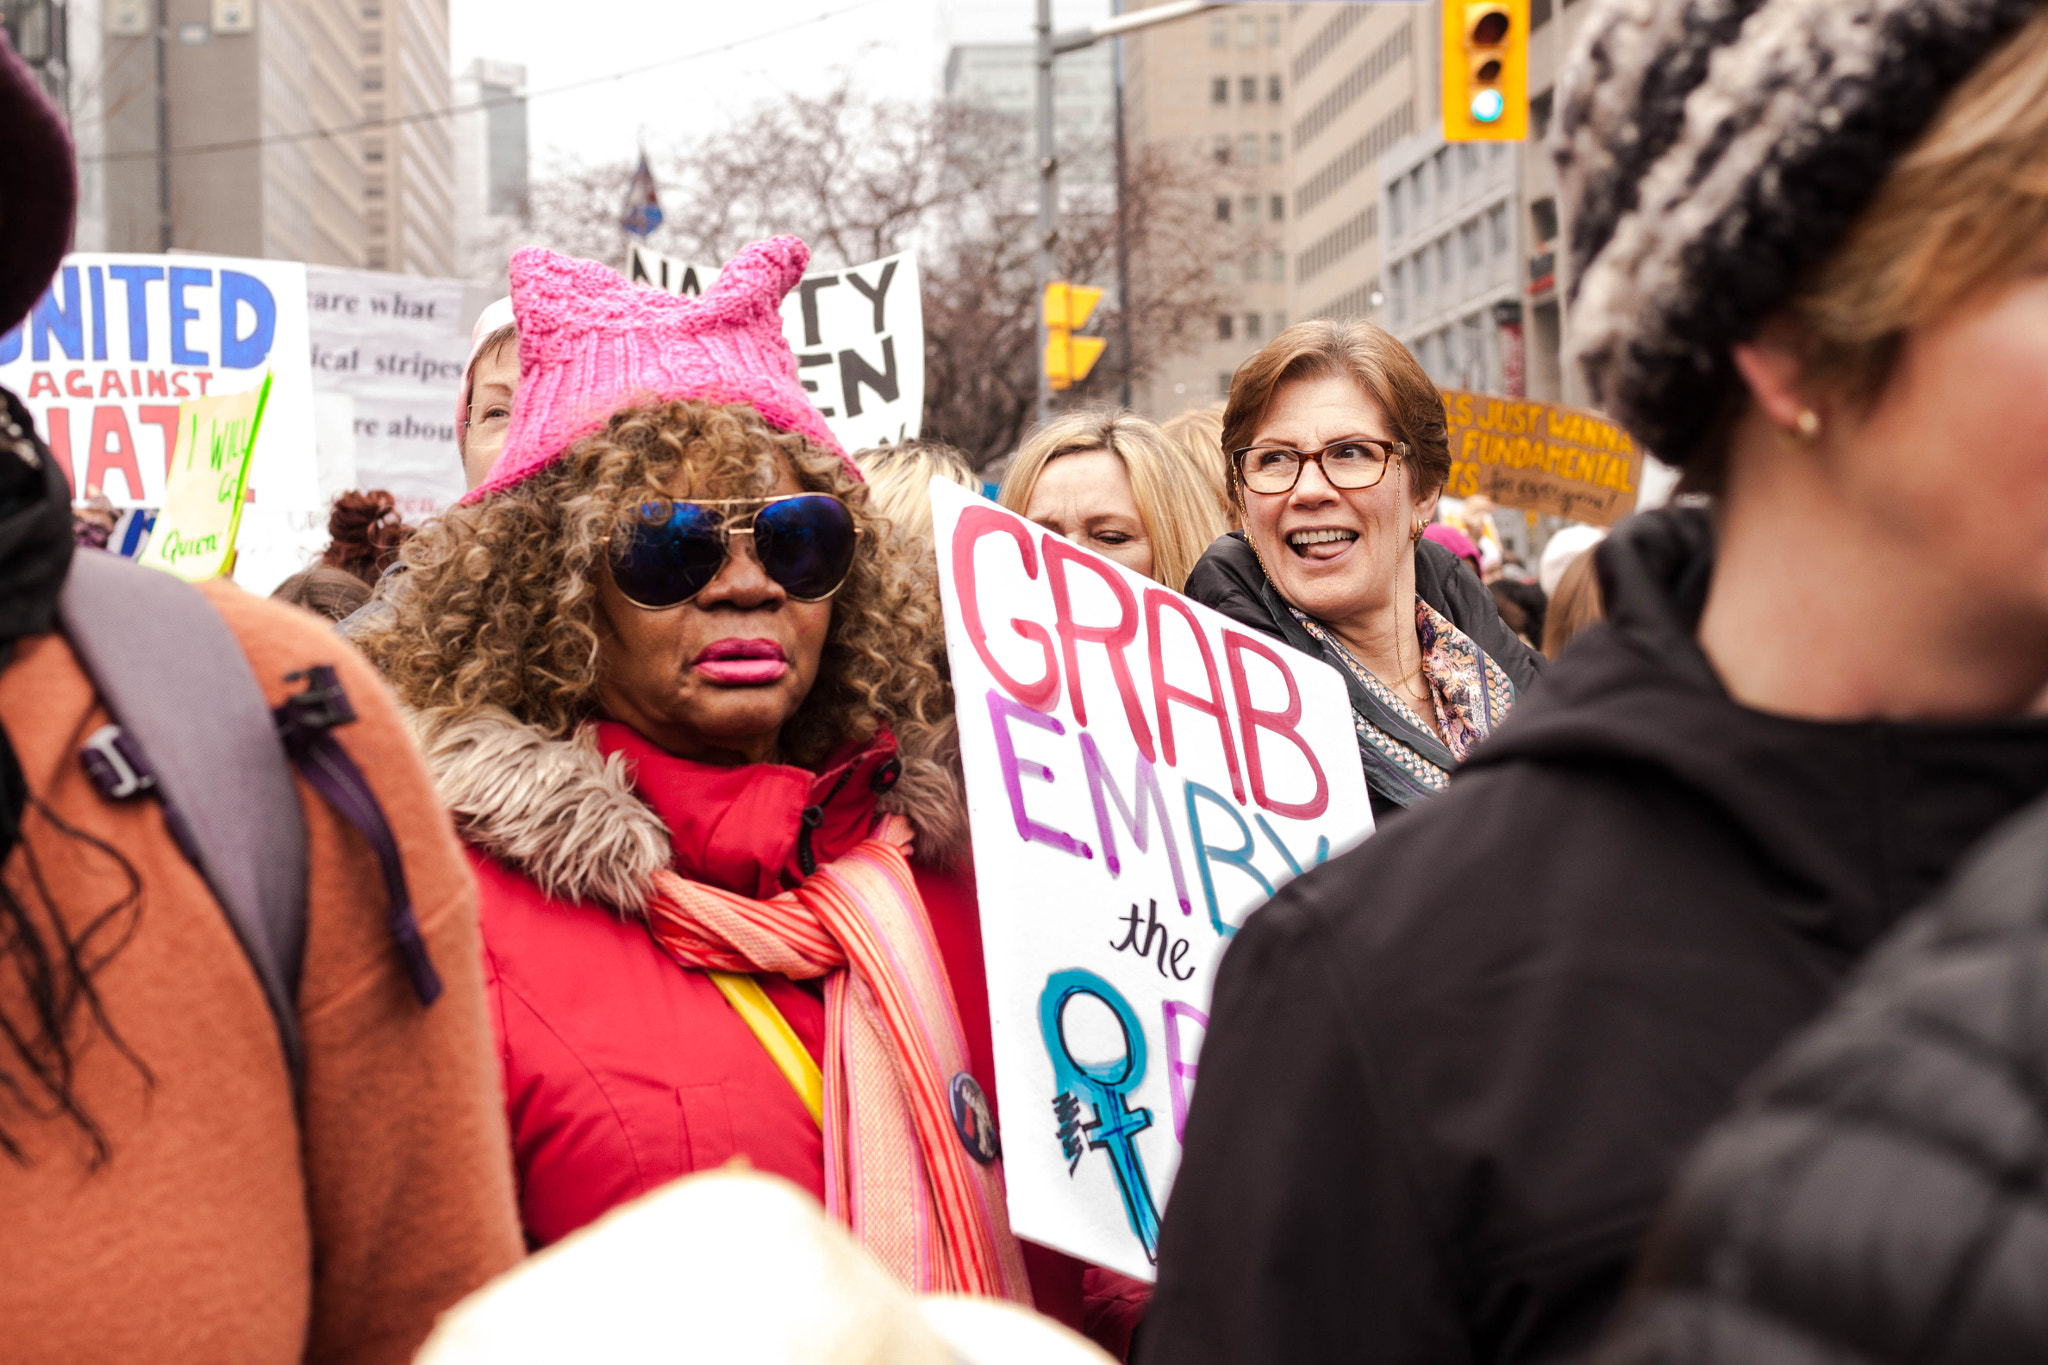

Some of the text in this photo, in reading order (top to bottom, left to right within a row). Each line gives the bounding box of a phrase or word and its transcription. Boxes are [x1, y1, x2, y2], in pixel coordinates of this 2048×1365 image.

[370, 293, 437, 320] what
[28, 370, 214, 399] AGAINST
[374, 352, 467, 382] stripes
[47, 405, 256, 503] AT
[1476, 399, 1544, 435] JUST
[1547, 409, 1634, 456] WANNA
[1461, 429, 1633, 493] FUNDAMENTAL
[951, 504, 1330, 821] GRAB
[1109, 898, 1197, 981] the
